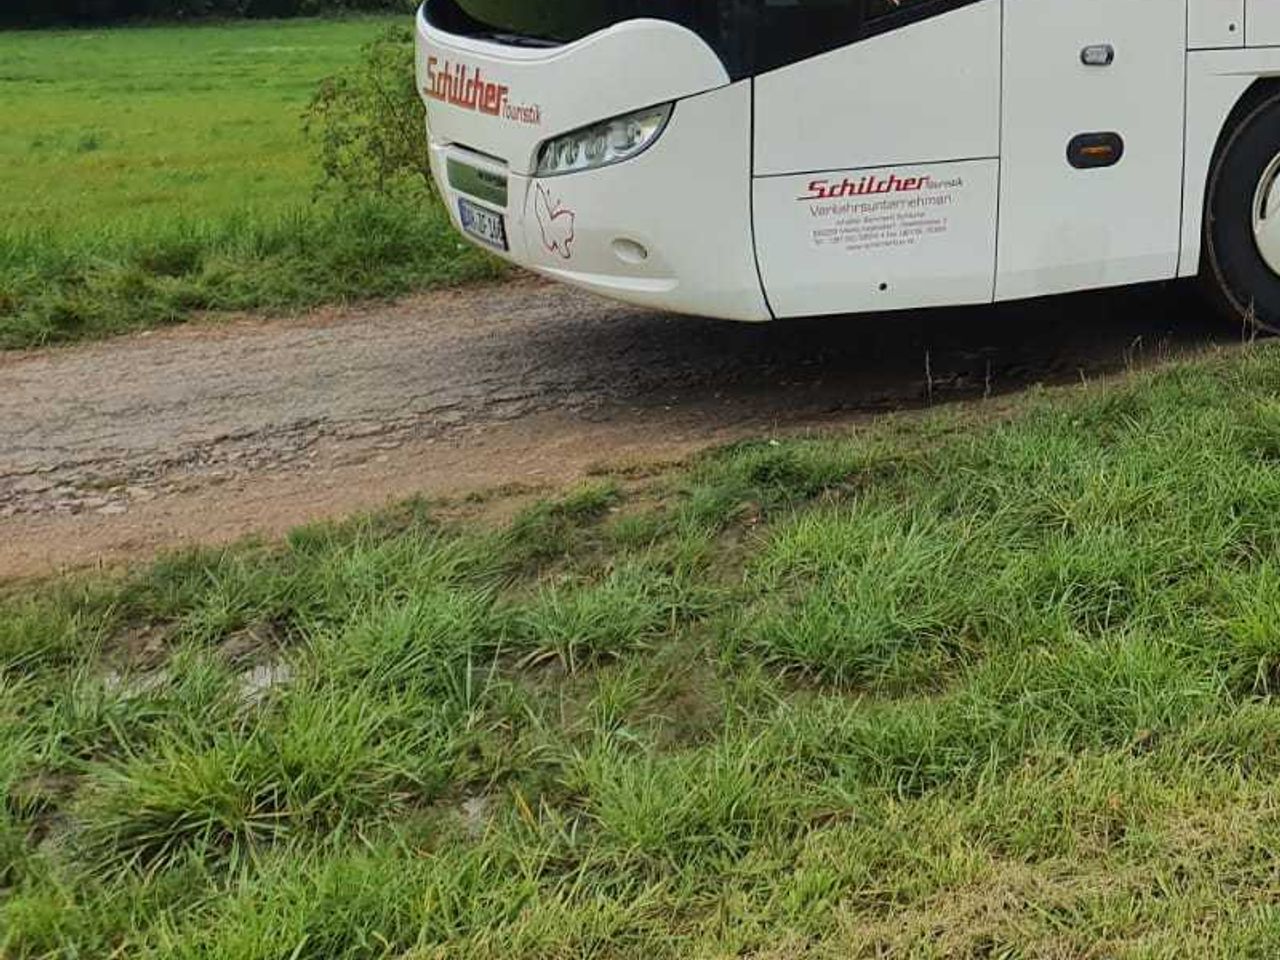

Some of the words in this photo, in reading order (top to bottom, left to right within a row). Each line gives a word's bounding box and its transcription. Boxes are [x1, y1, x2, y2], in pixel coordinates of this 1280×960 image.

[424, 56, 509, 116] Schilcher
[502, 98, 541, 124] Touristik
[797, 174, 931, 201] Schilcher
